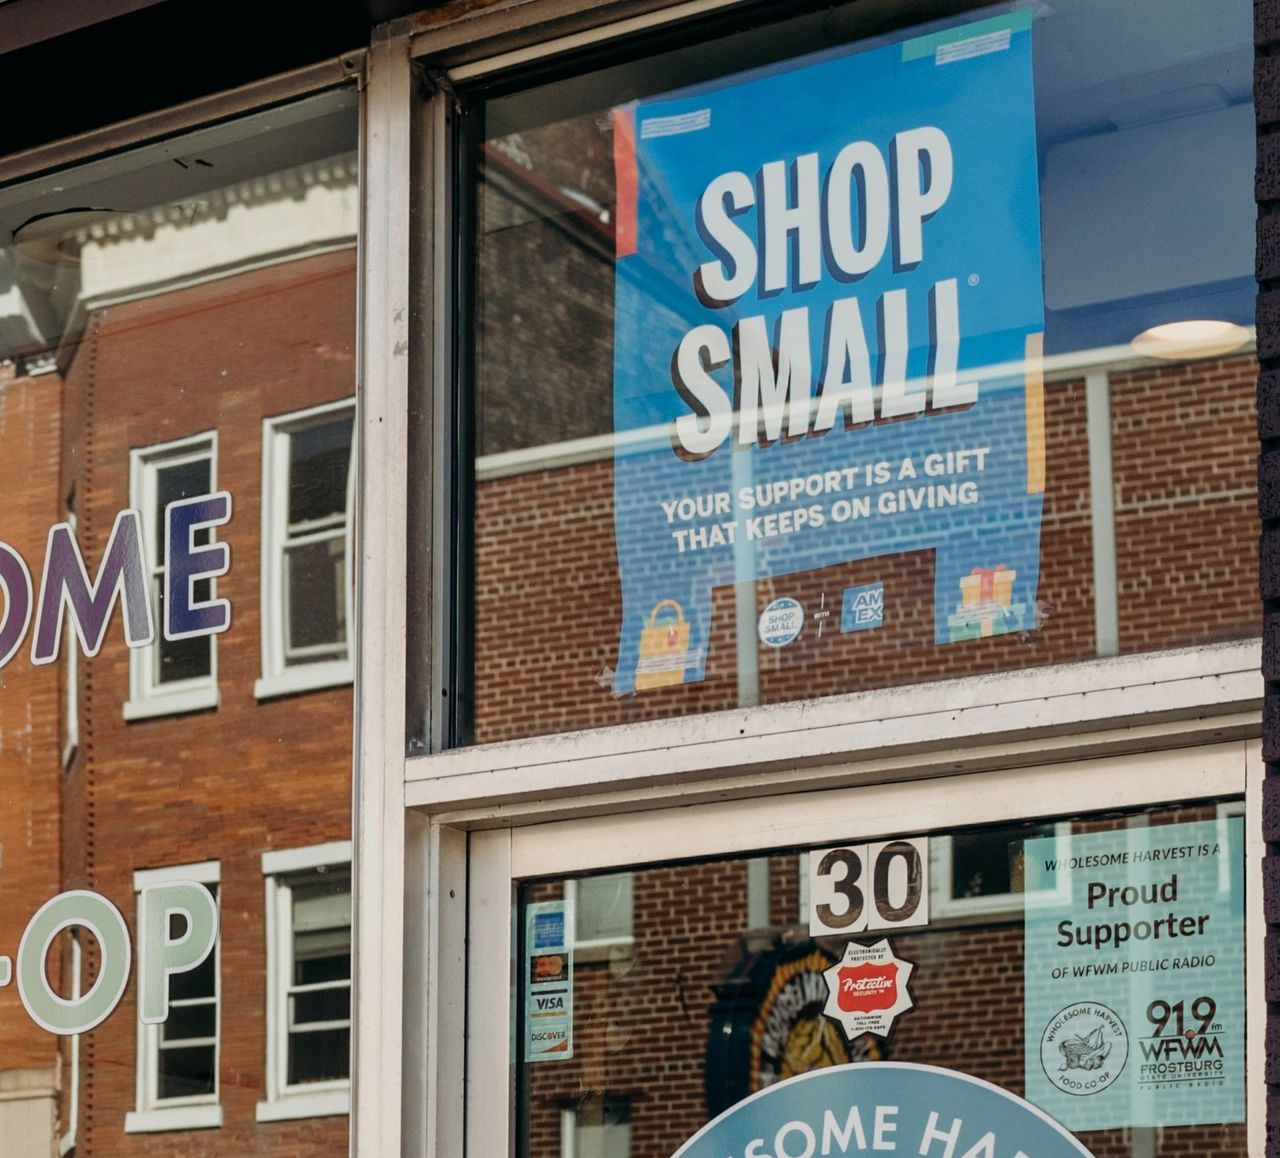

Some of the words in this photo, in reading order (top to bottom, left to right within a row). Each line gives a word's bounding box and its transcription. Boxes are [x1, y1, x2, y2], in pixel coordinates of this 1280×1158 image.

[694, 126, 953, 309] SHOP
[661, 492, 730, 523] YOUR
[738, 466, 859, 509] SUPPORT
[866, 463, 891, 486] IS
[898, 458, 917, 481] A
[924, 448, 989, 475] GIFT
[672, 522, 737, 552] THAT
[746, 505, 823, 541] KEEPS
[831, 496, 870, 523] ON
[878, 482, 978, 514] GIVING
[768, 613, 795, 625] SHOP
[1045, 853, 1129, 871] WHOLESOME
[1133, 846, 1194, 863] HARVEST
[1198, 845, 1209, 856] IS
[1212, 844, 1222, 855] A
[816, 841, 922, 928] 30
[1088, 874, 1178, 909] Proud
[1057, 913, 1209, 949] Supporter
[1052, 967, 1069, 979] OF
[1073, 963, 1118, 976] WFWM
[1121, 959, 1168, 974] PUBLIC
[1172, 955, 1215, 969] RADIO
[842, 976, 894, 992] Protective
[536, 997, 563, 1010] VISA
[531, 1031, 566, 1042] DISCOVER
[1046, 1007, 1091, 1043] WHOLESOME
[1093, 1009, 1122, 1038] HARVEST
[1211, 1023, 1222, 1031] fm
[1139, 1037, 1224, 1062] WFWM
[1058, 1074, 1082, 1090] FOOD
[1085, 1071, 1110, 1090] CO-OP
[1140, 1060, 1223, 1076] FROSTBURG
